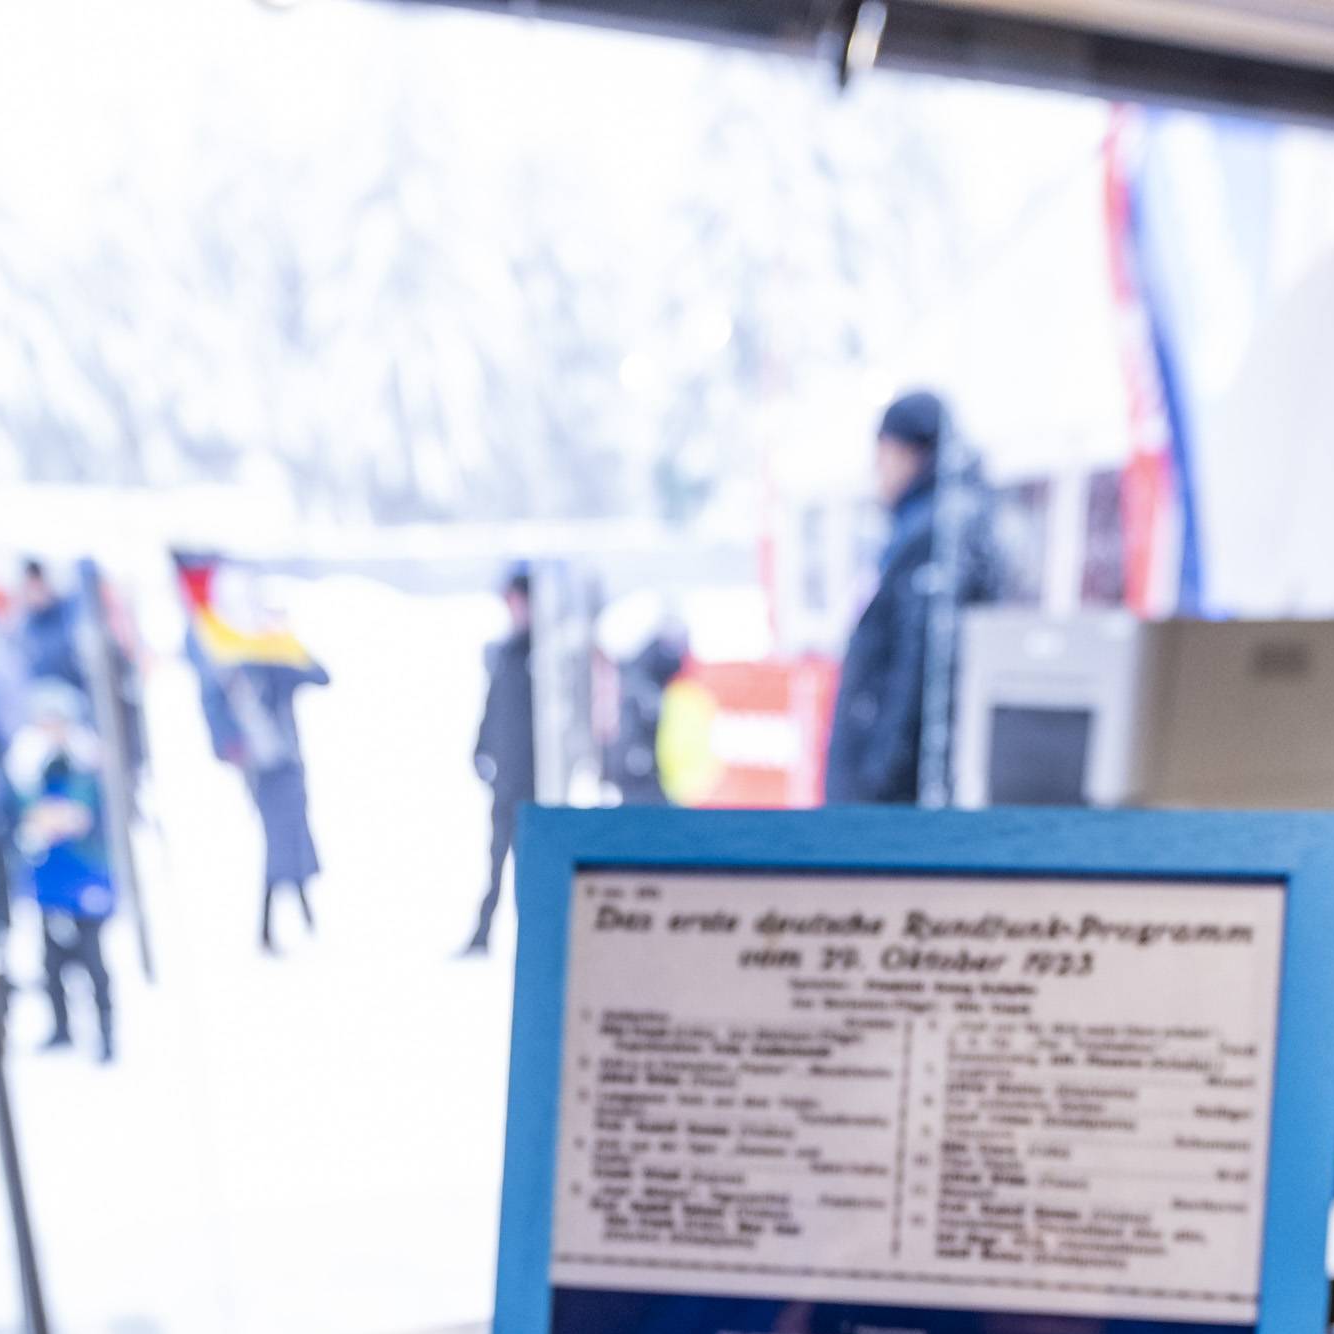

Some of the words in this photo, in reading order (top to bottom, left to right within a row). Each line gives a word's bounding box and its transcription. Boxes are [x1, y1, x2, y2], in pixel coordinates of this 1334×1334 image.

[595, 904, 652, 932] Das
[668, 912, 739, 934] erste
[753, 908, 884, 937] deutsche
[738, 949, 803, 970] vom
[880, 944, 1008, 974] Oktober
